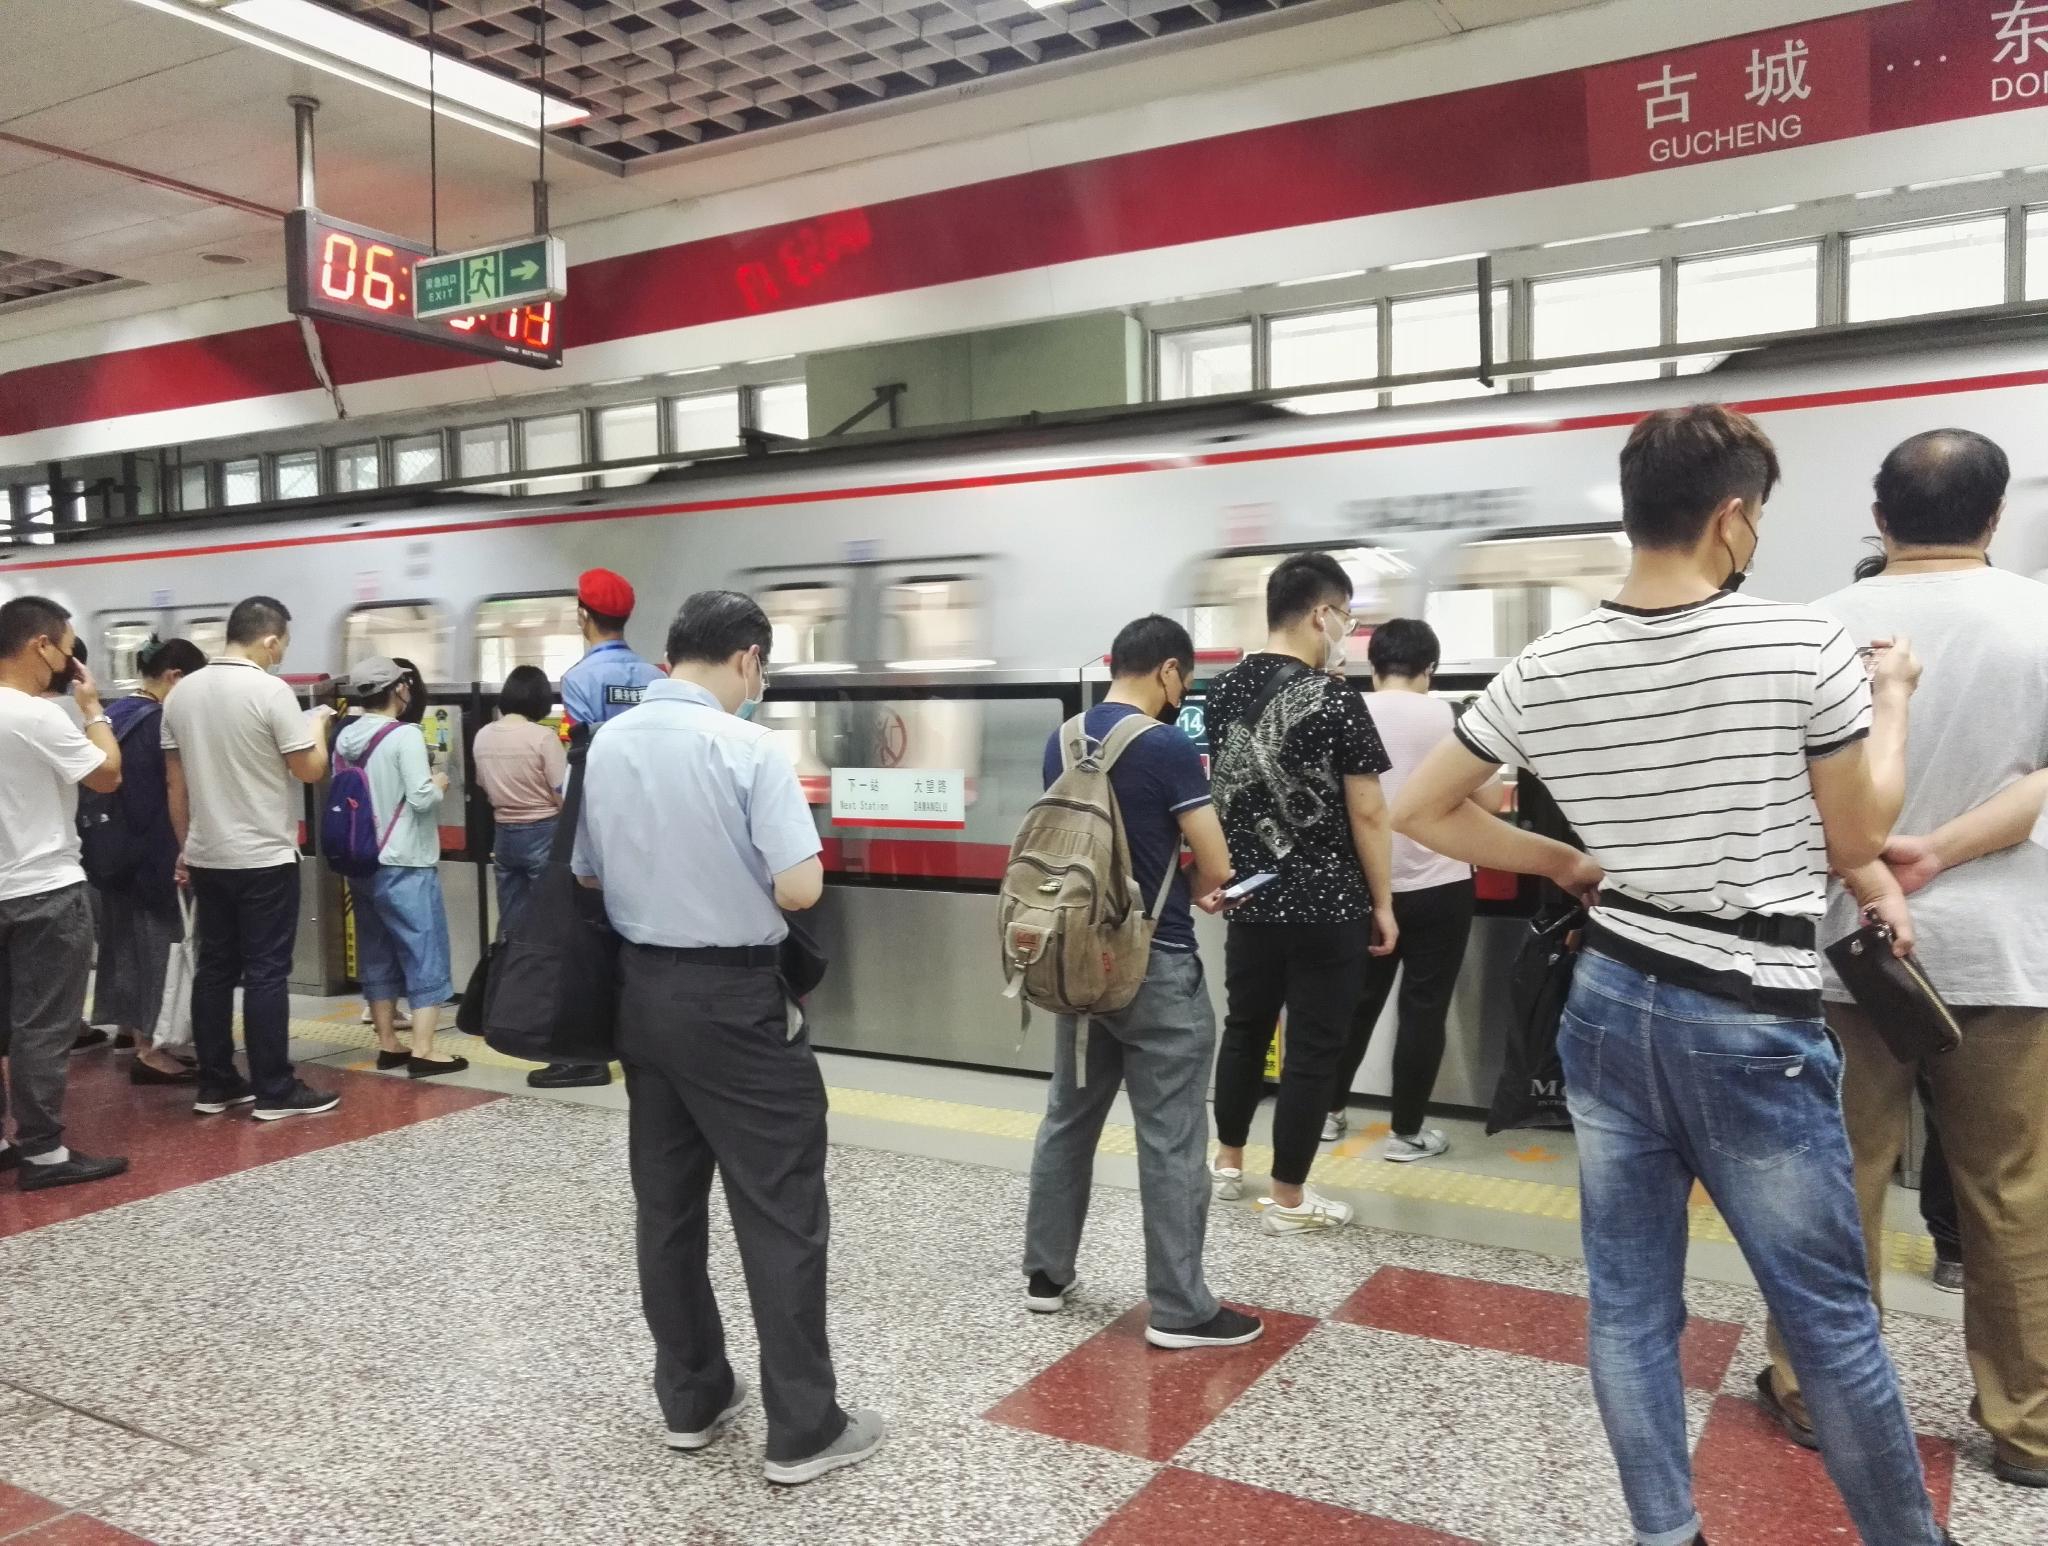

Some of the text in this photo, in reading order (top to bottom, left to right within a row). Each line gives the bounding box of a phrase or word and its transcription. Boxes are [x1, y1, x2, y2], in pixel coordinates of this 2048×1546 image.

[1637, 38, 1812, 129] 古城
[1649, 114, 1802, 163] GUCHENG
[428, 288, 454, 303] EXIT
[1180, 712, 1201, 732] 14
[1221, 727, 1251, 776] TORONTO
[848, 778, 879, 792] 下一站
[840, 800, 857, 810] Next
[860, 801, 889, 811] Station
